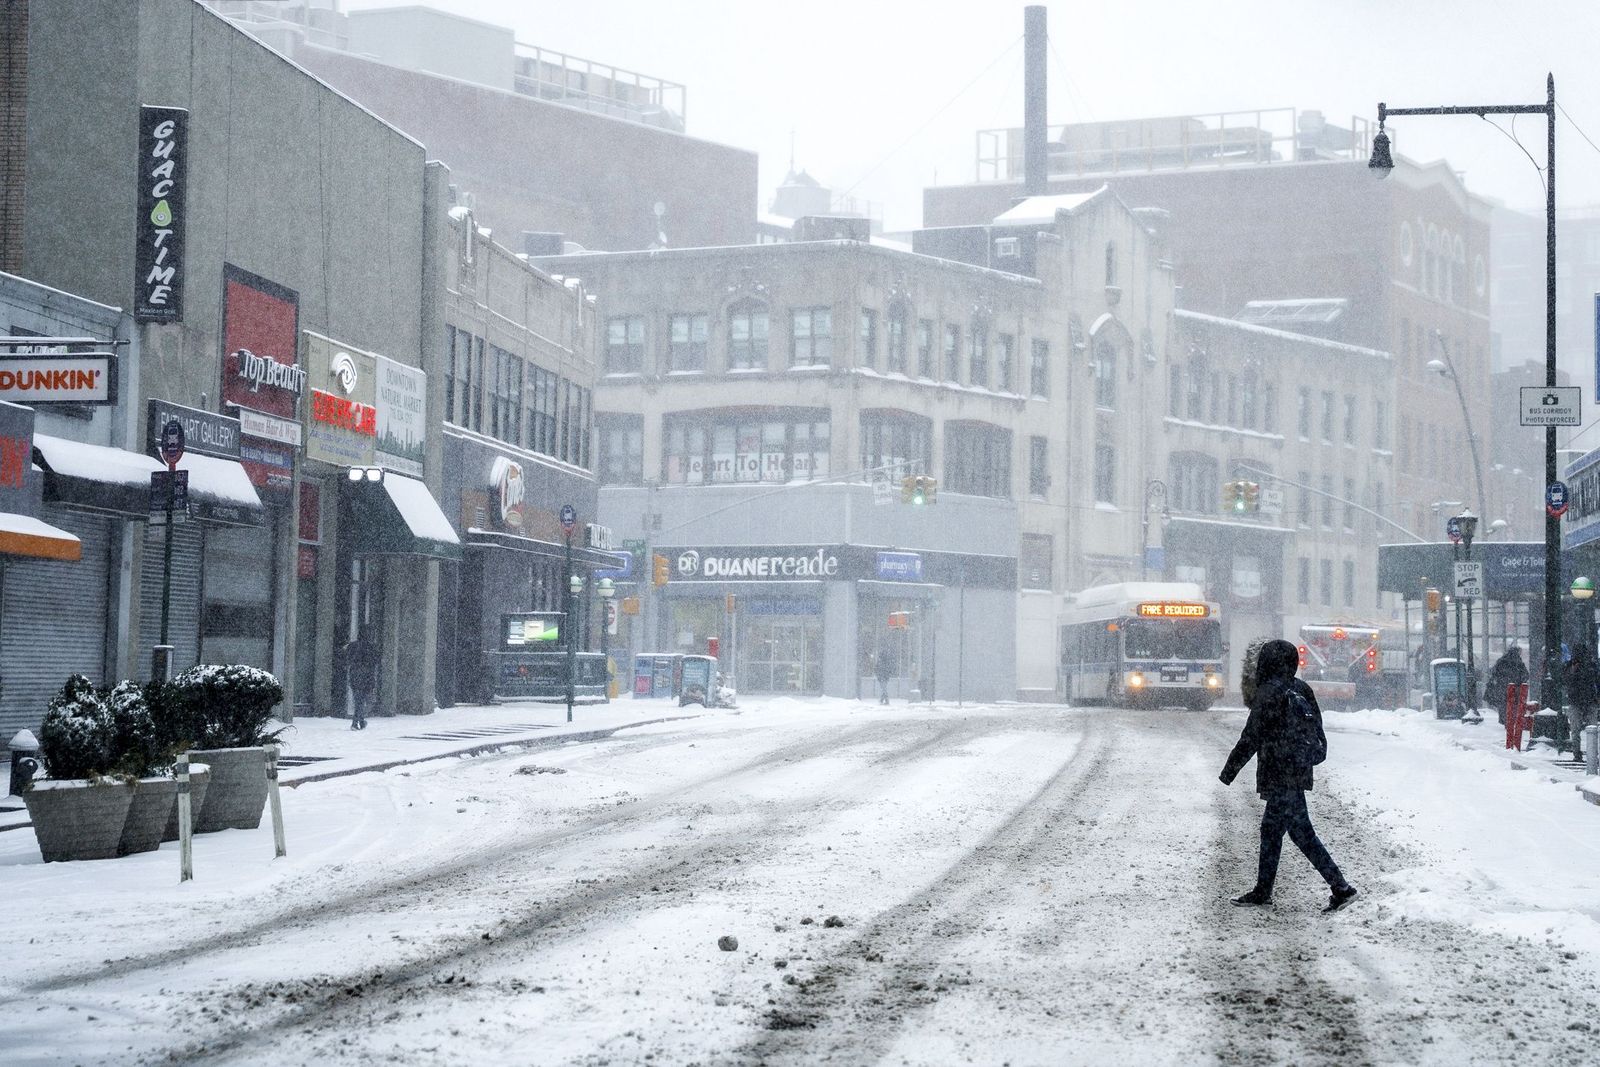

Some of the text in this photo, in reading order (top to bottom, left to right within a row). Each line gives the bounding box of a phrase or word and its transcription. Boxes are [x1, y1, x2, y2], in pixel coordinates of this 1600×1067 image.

[146, 120, 176, 304] GUAC TIME
[0, 369, 101, 391] DUNKIN'
[238, 350, 265, 393] Top
[184, 418, 200, 442] ART
[201, 421, 235, 449] GALLERY
[679, 454, 819, 473] Heart To Heart
[1457, 564, 1479, 572] STOP
[1463, 587, 1480, 595] RED
[1141, 604, 1204, 615] FARE REQUIRED
